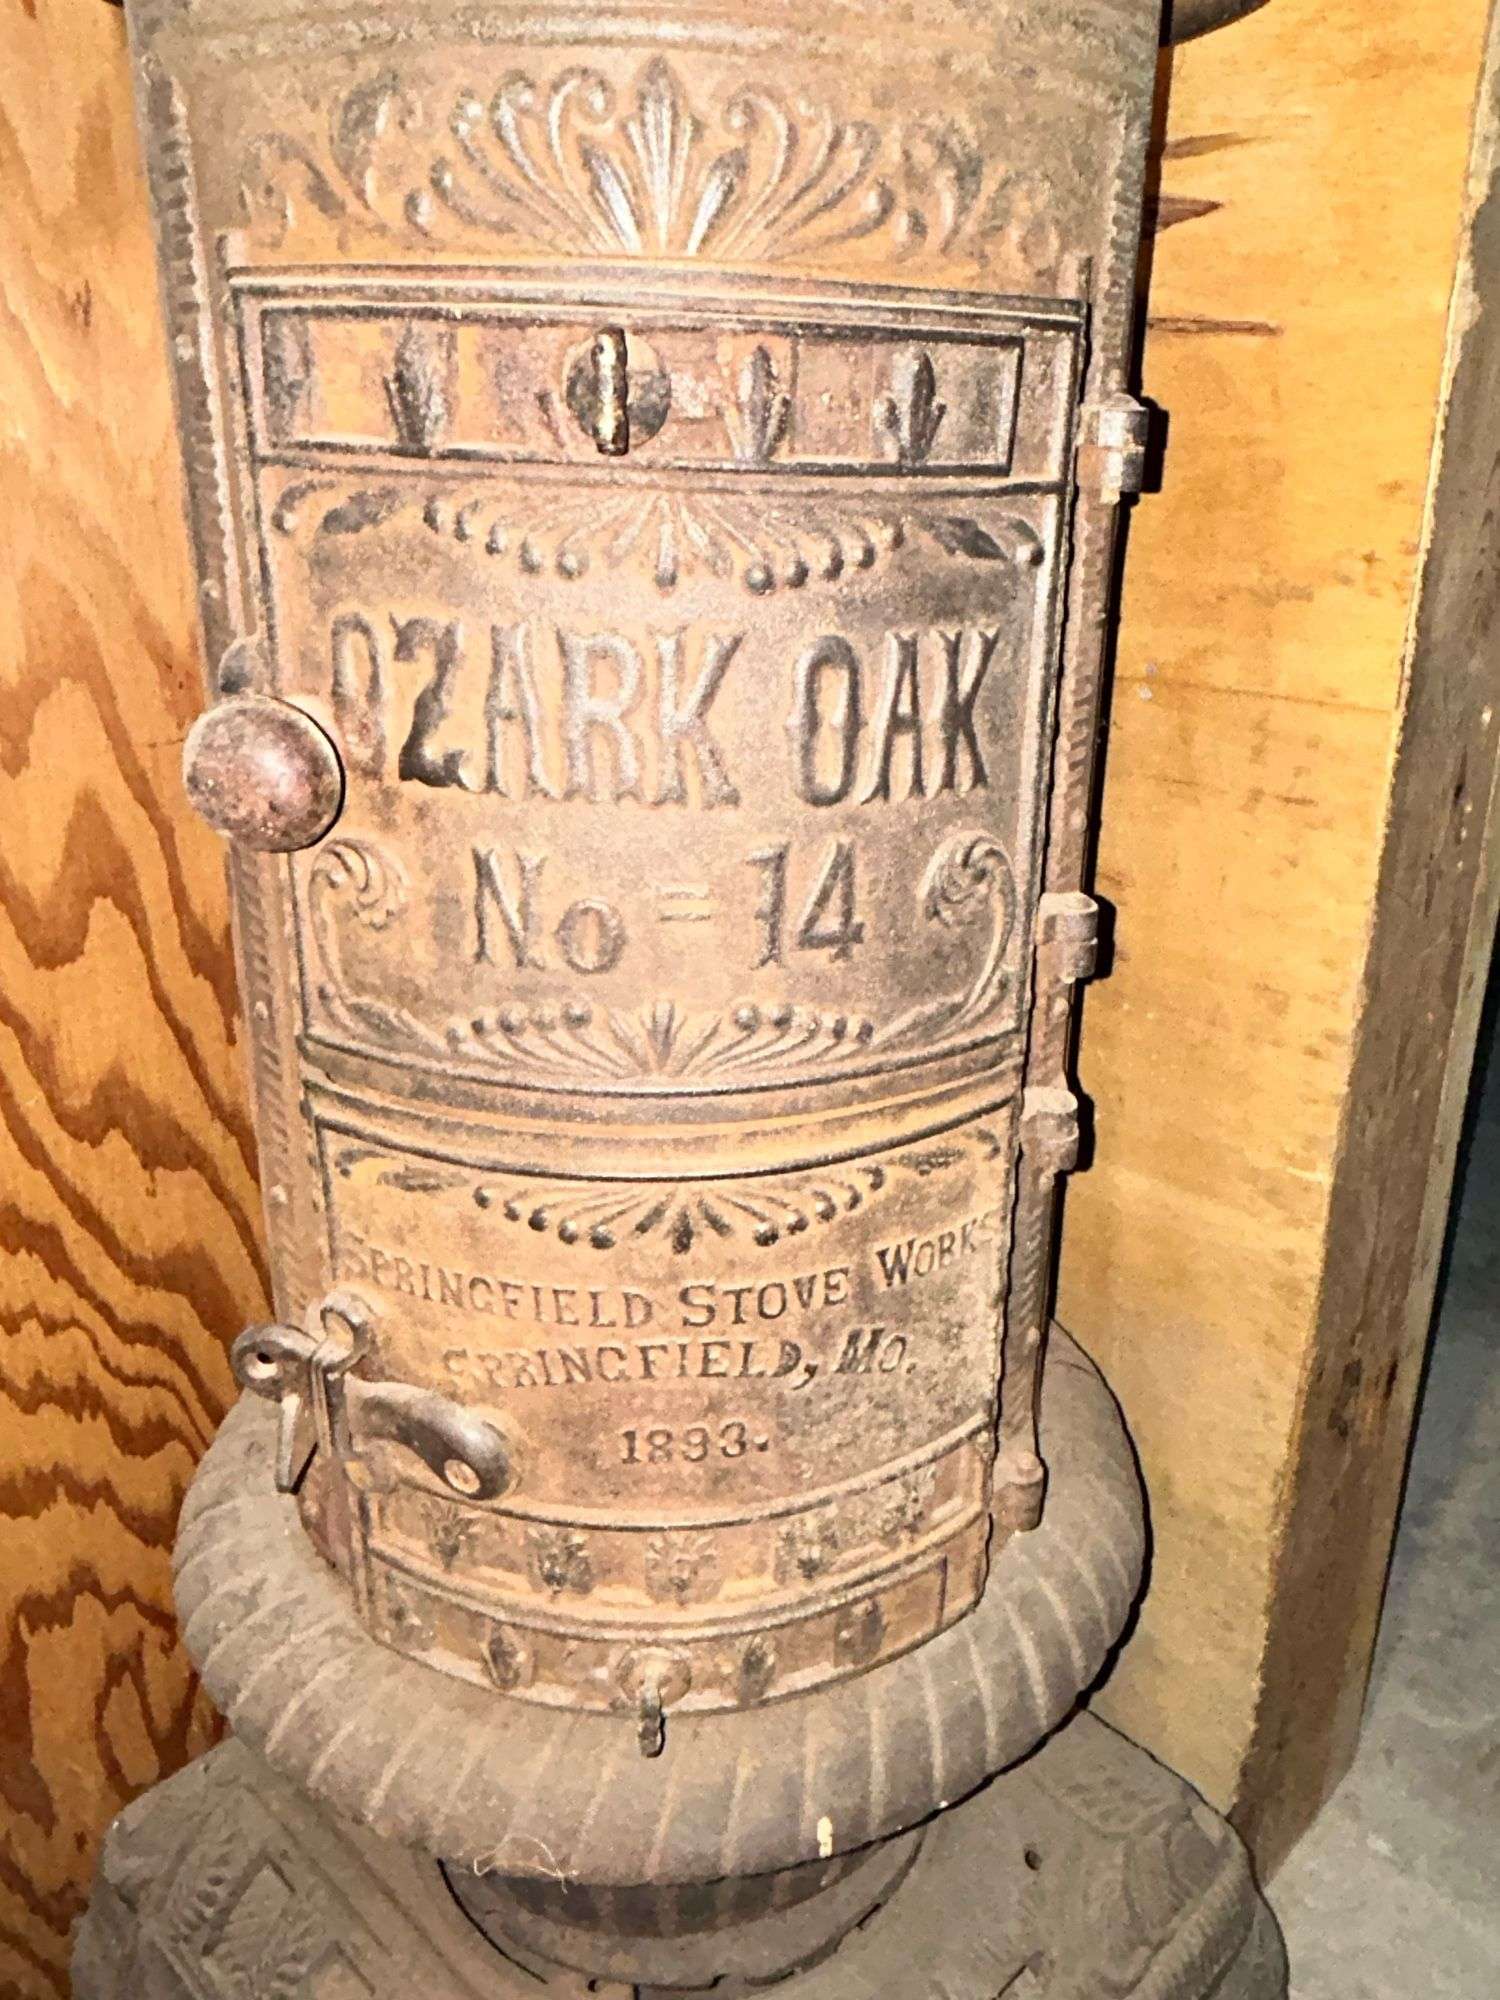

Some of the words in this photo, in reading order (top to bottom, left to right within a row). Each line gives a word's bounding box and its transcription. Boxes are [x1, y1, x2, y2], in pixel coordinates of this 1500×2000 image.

[330, 611, 744, 808] OZARK
[785, 624, 999, 808] OAK
[745, 840, 866, 971] 14
[338, 1234, 655, 1329] SPRINGFIELD
[678, 1267, 849, 1328] STOVE
